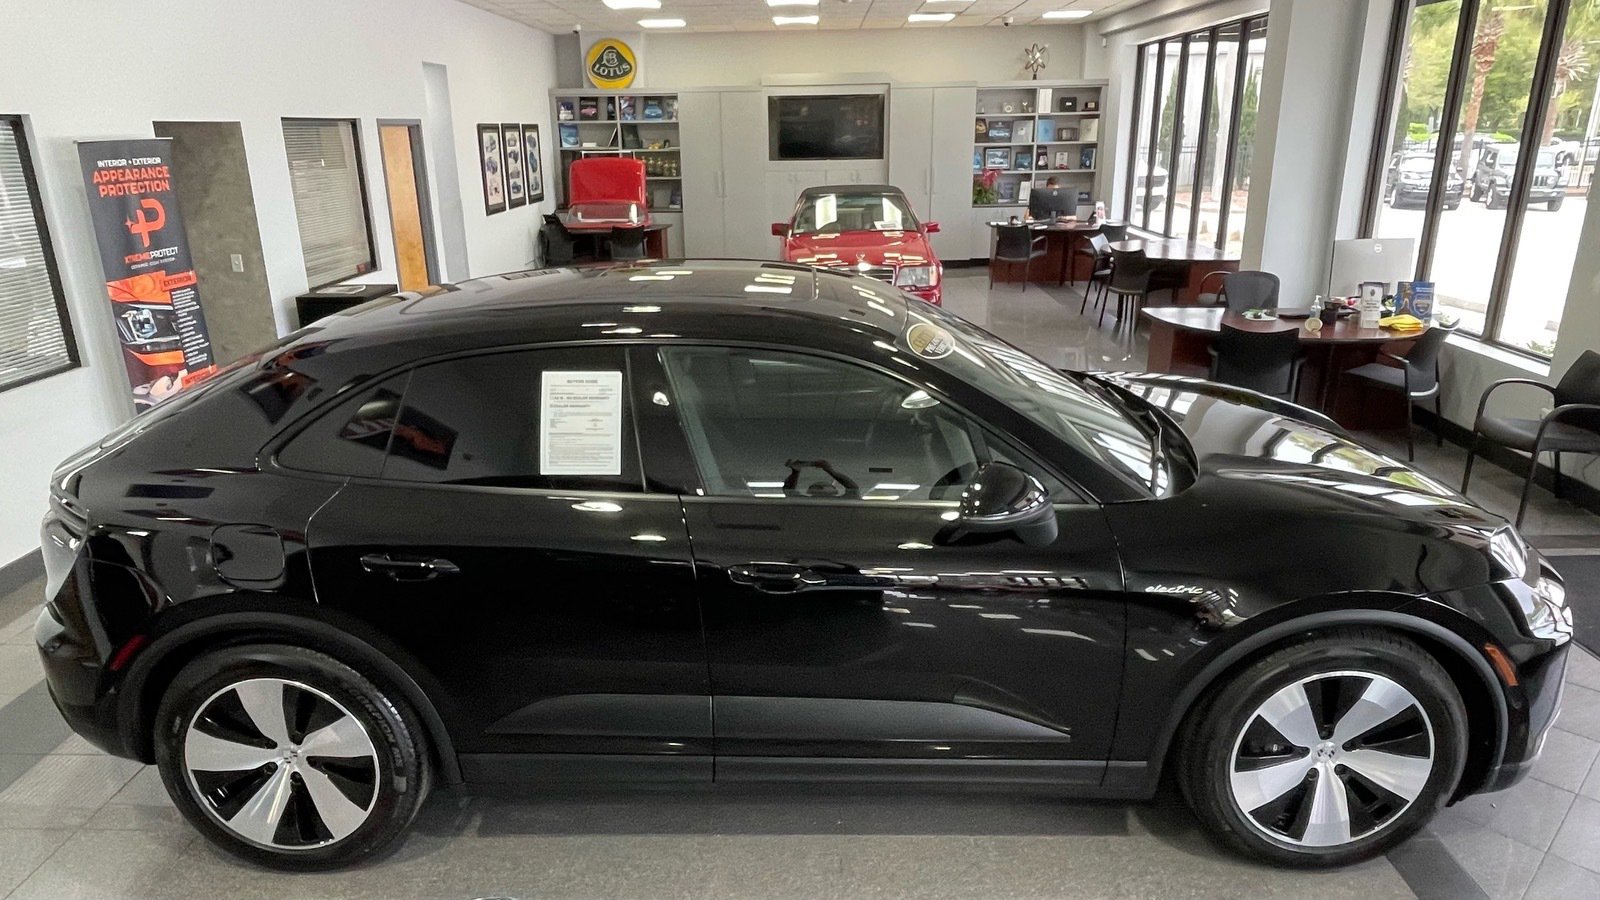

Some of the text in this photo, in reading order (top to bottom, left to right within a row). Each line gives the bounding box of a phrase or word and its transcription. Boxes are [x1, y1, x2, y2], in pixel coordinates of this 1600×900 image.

[593, 63, 630, 76] LOTUS
[97, 157, 161, 167] INTERIOR EXTERIOR
[93, 166, 170, 183] APPEARANCE
[99, 179, 170, 198] PROTECTION
[164, 276, 191, 287] EXTERIOR
[1145, 584, 1204, 594] electric
